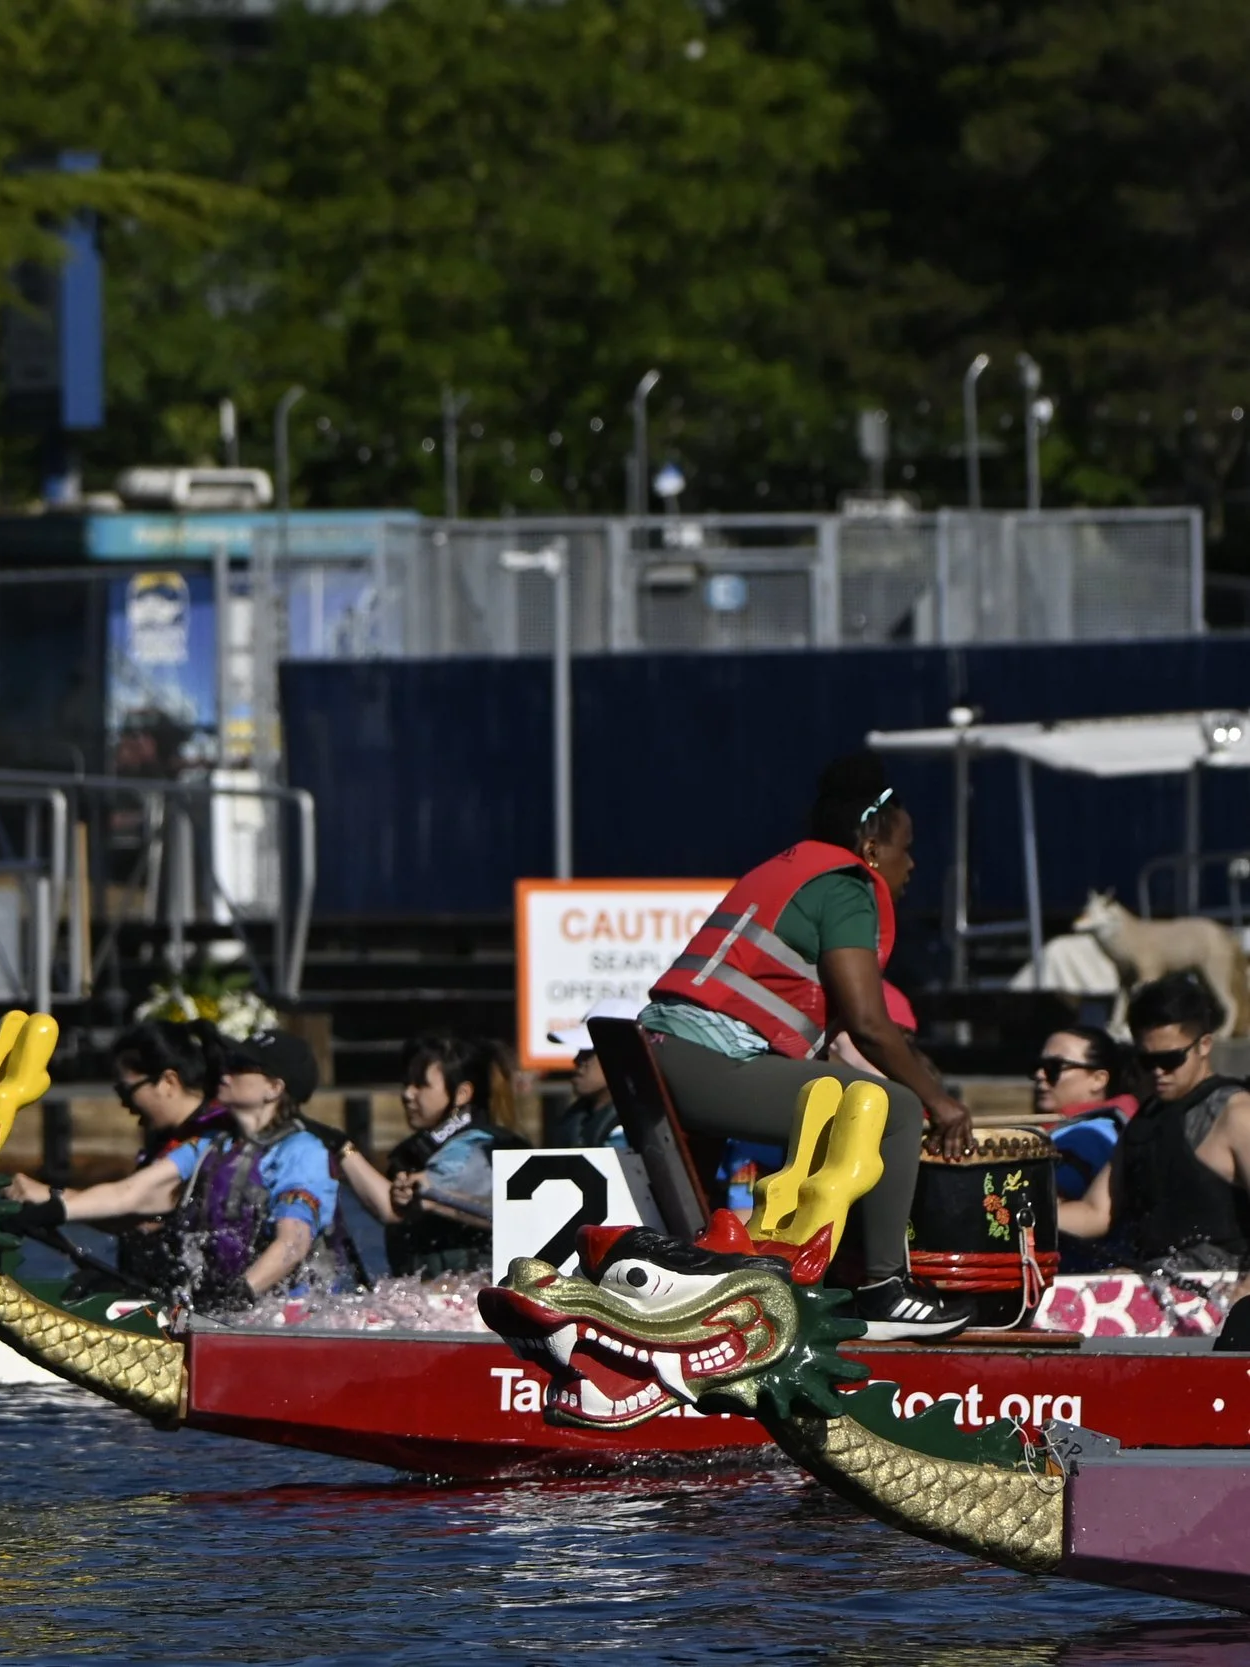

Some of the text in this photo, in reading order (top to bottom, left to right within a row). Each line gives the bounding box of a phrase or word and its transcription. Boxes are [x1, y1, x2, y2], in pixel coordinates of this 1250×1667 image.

[559, 908, 714, 943] CAUTIO
[592, 951, 677, 971] SEAPL
[547, 979, 648, 1002] OPERAT
[506, 1154, 608, 1271] 2
